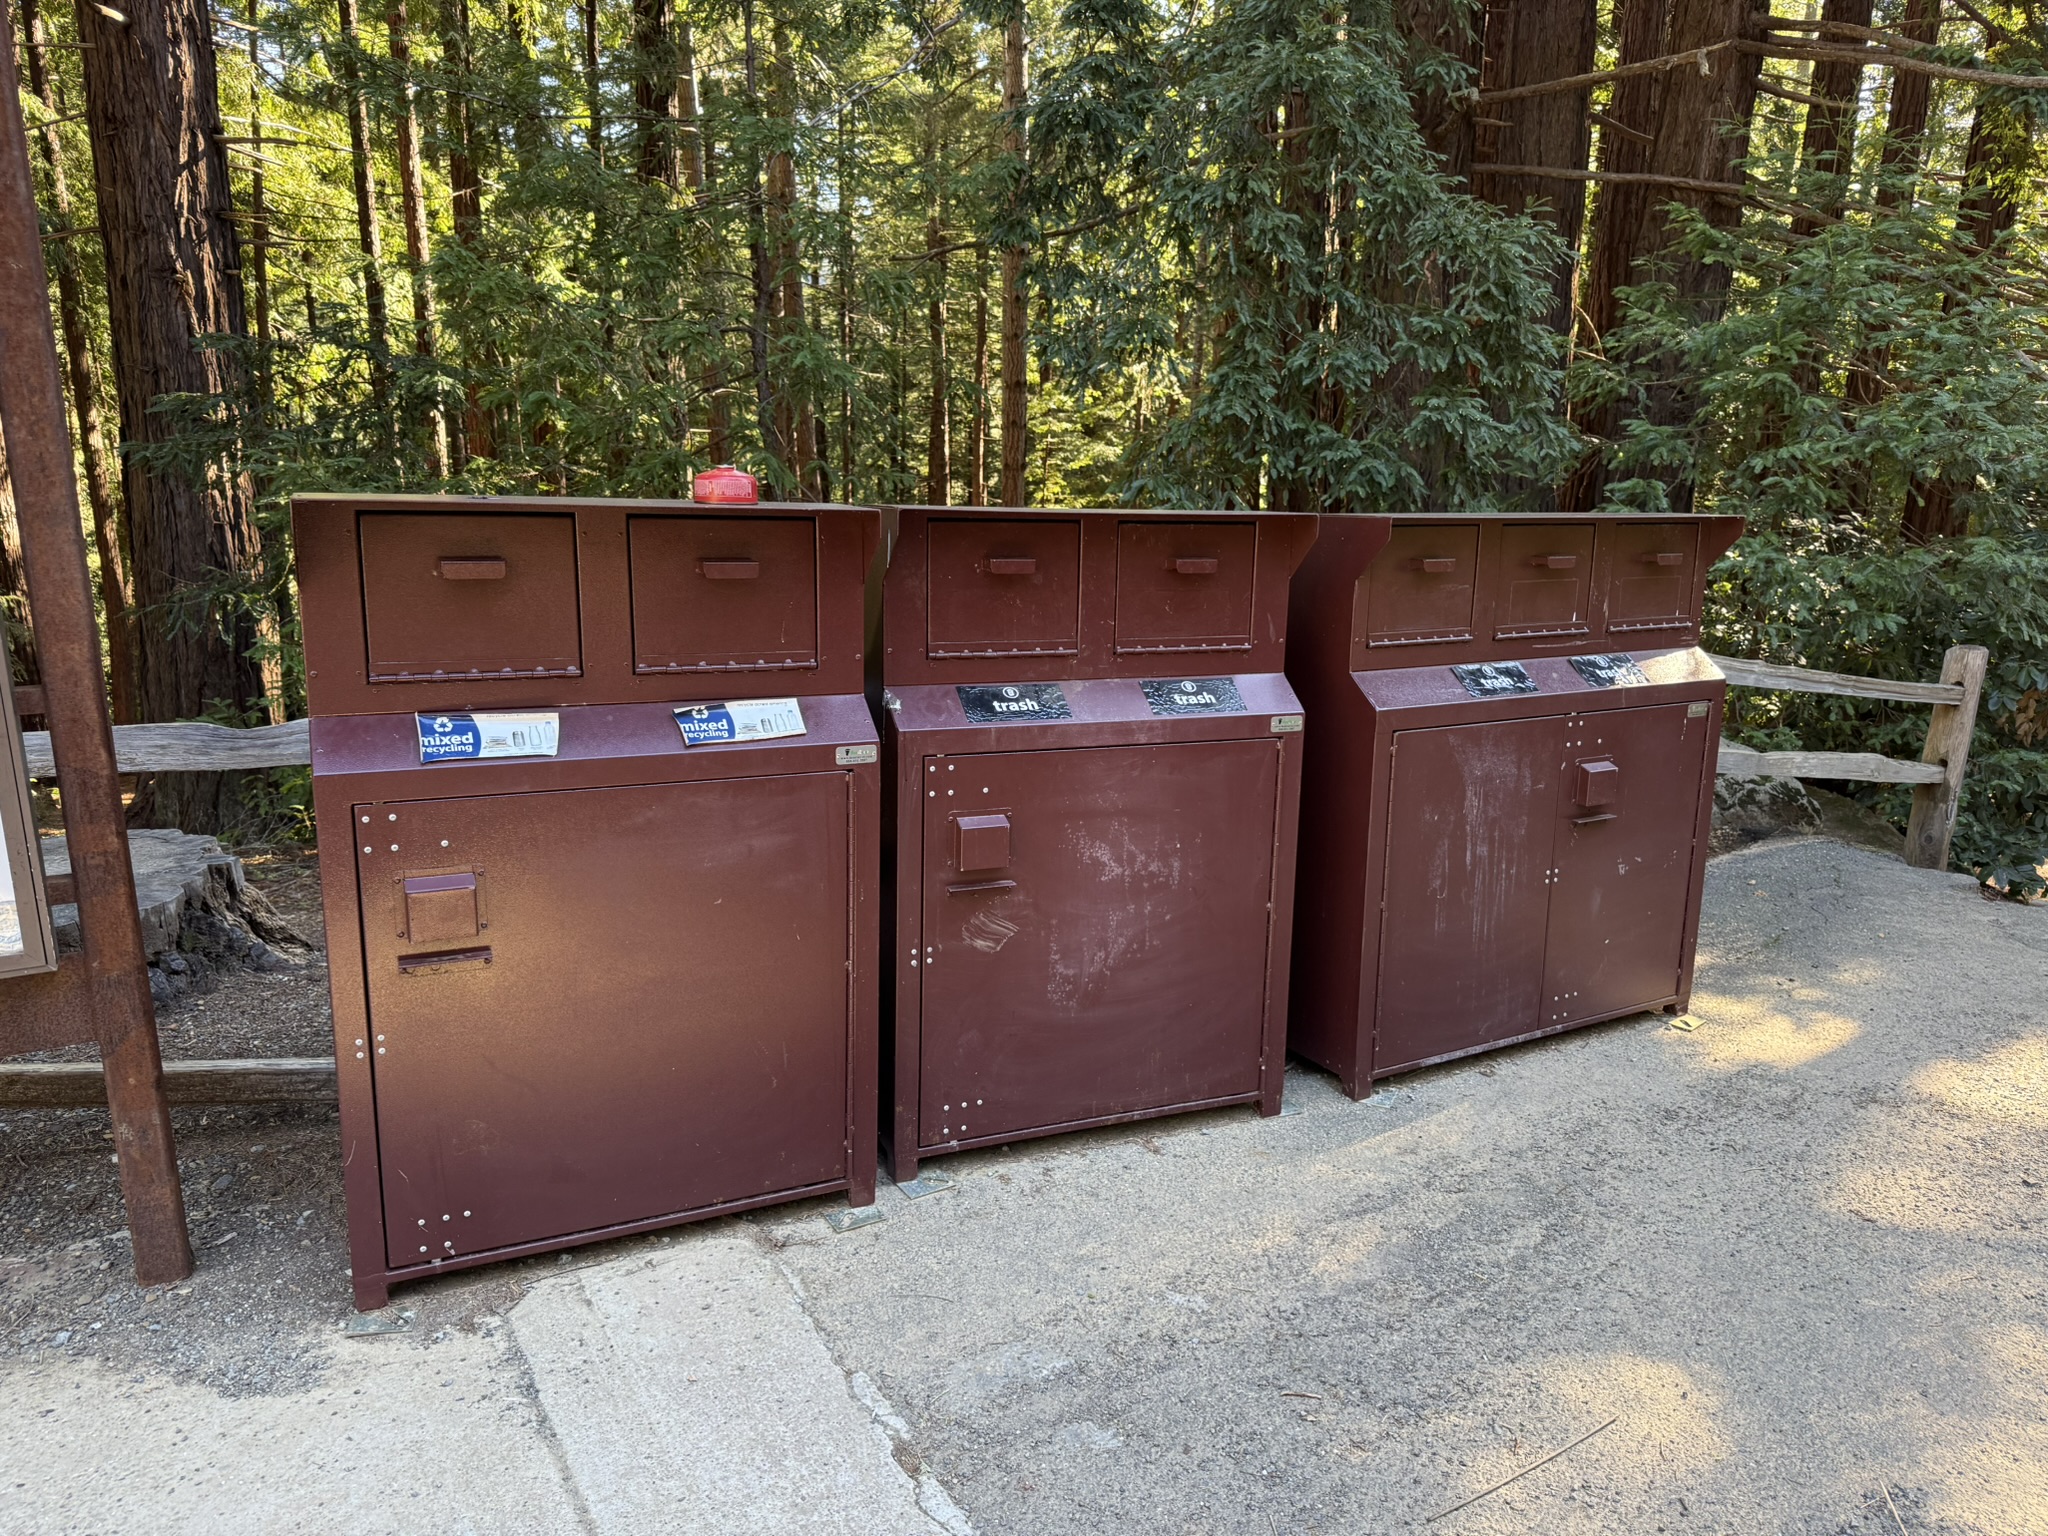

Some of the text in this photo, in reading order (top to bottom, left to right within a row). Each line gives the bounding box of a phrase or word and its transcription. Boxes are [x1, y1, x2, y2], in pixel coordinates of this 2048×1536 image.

[1480, 675, 1513, 686] trash
[1173, 691, 1216, 704] trash
[992, 698, 1039, 711] trash
[680, 718, 728, 731] mixed
[421, 732, 474, 745] mixed
[684, 730, 728, 739] recycling
[422, 744, 473, 754] recycling
